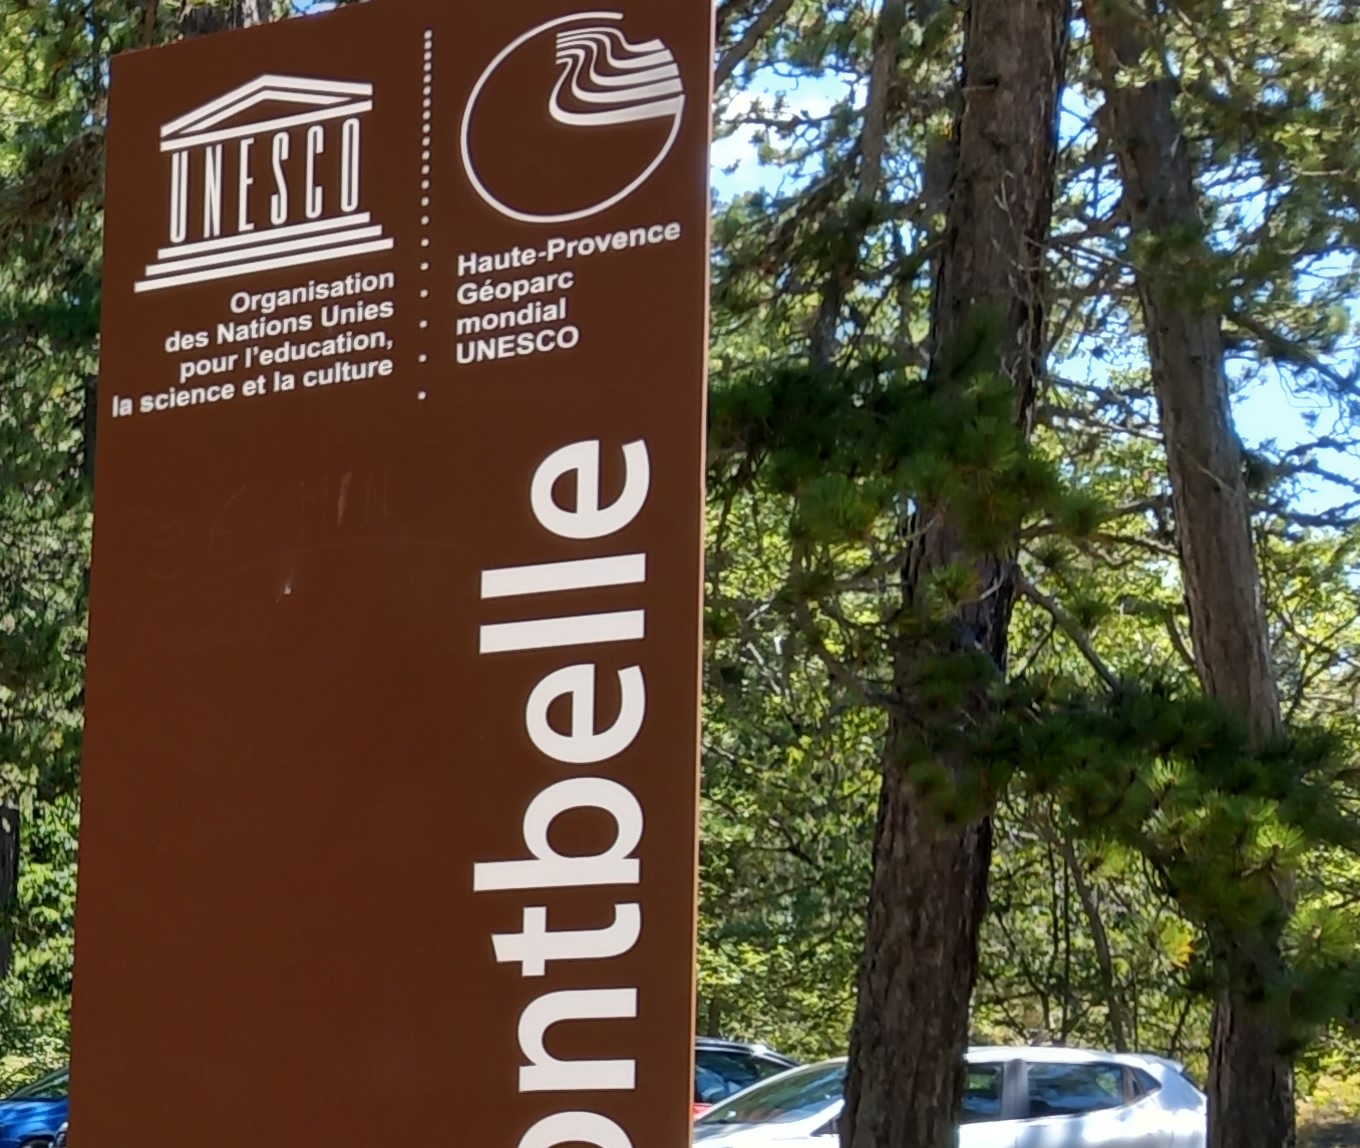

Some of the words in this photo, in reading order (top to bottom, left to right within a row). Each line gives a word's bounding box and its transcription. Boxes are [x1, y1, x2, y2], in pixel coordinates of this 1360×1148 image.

[170, 117, 360, 244] UNESCO
[457, 222, 681, 277] Haute-Provence
[230, 272, 394, 314] Organisation
[456, 271, 574, 305] Géoparc
[164, 330, 209, 353] des
[216, 314, 313, 345] Nations
[321, 301, 394, 327] Unies
[456, 297, 566, 336] mondial
[456, 325, 579, 364] UNESCO
[112, 395, 133, 418] la
[139, 383, 235, 413] science
[242, 374, 267, 397] et
[273, 371, 295, 392] la
[302, 359, 393, 388] culture
[179, 354, 239, 384] pour
